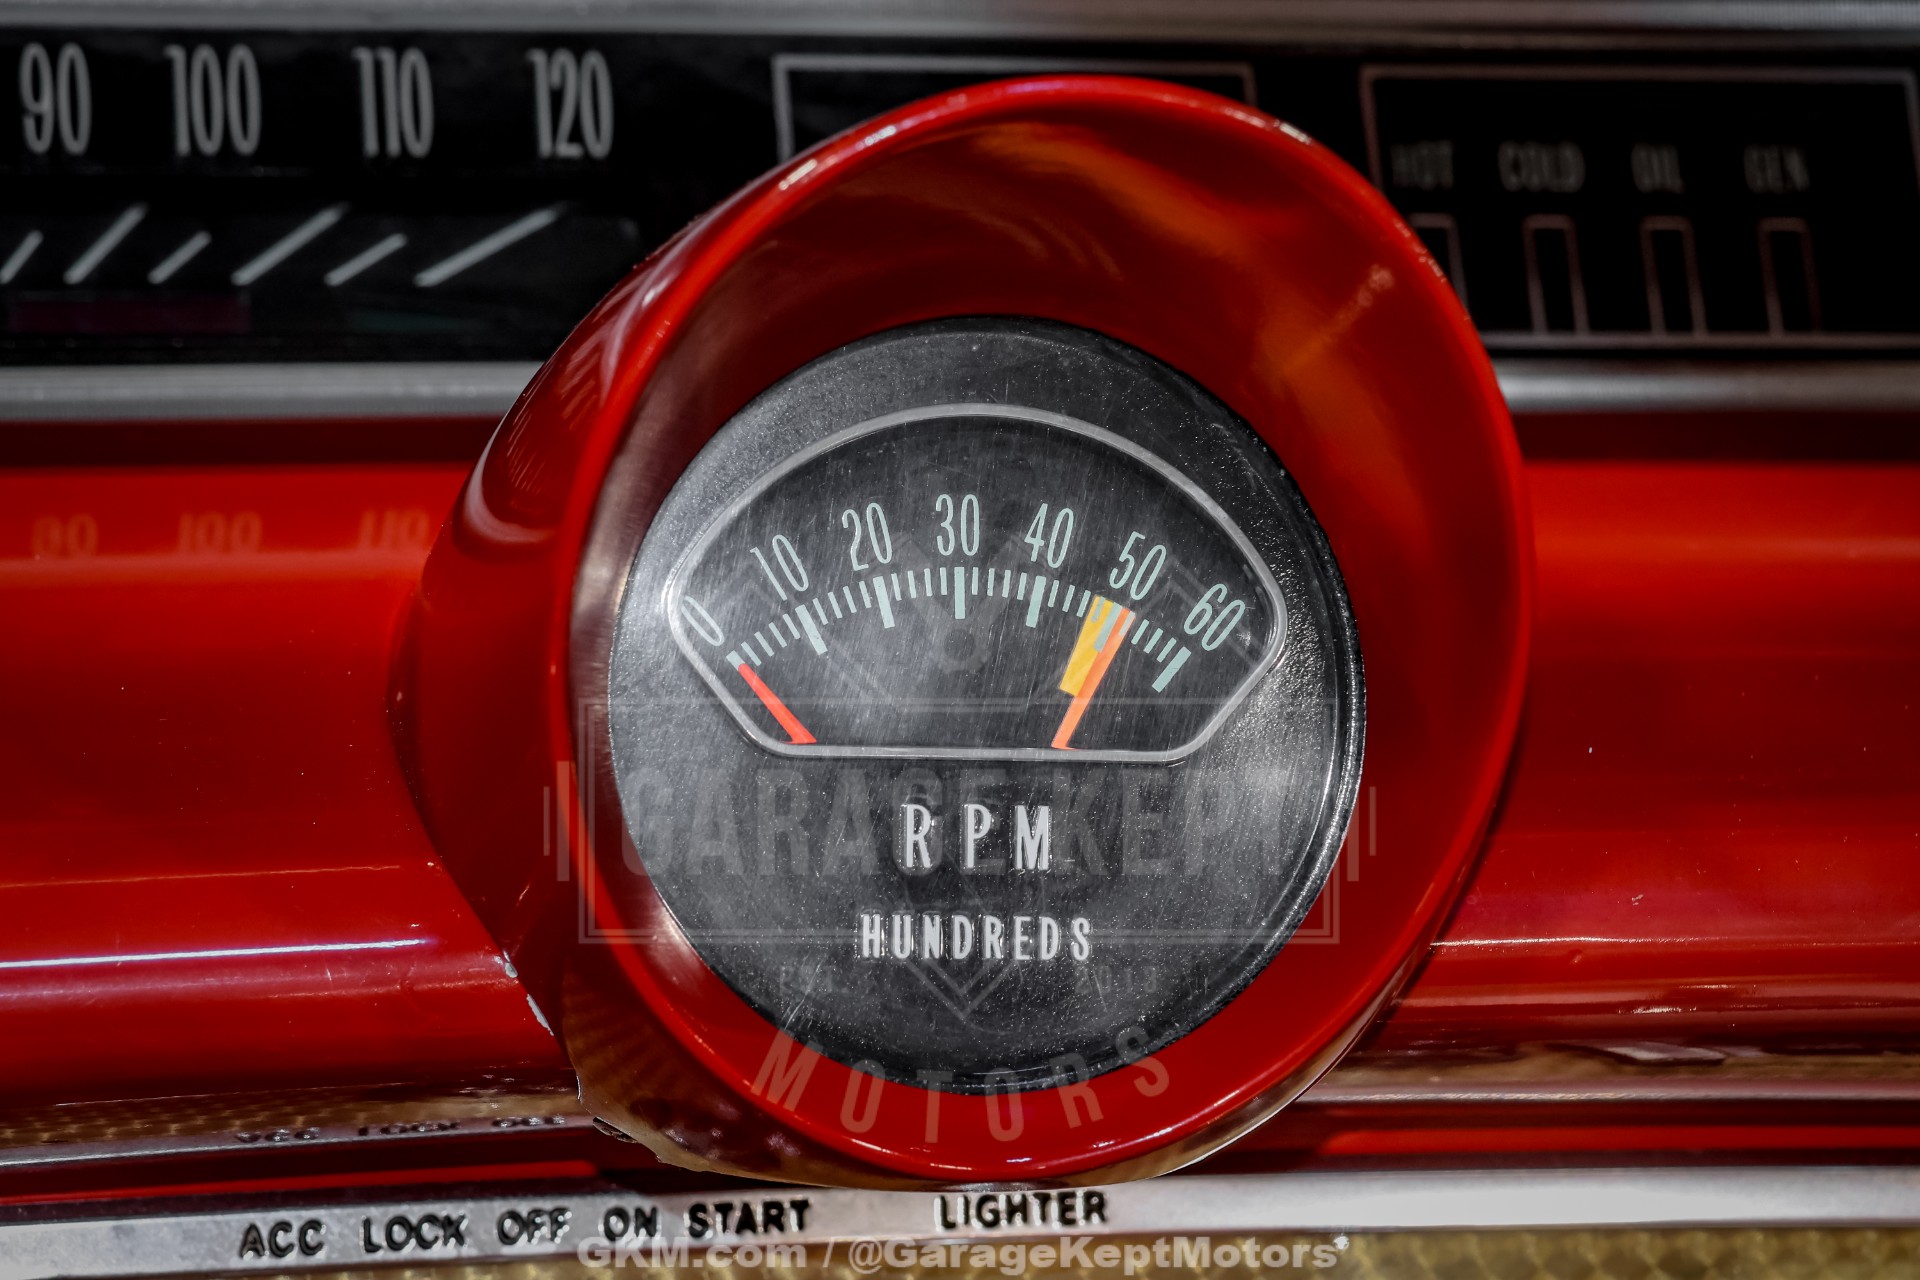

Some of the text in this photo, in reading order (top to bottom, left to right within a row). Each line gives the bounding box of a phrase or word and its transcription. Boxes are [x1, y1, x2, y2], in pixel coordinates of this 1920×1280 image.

[20, 43, 91, 155] 90
[163, 44, 261, 157] 100
[351, 46, 435, 159] 110
[525, 49, 613, 159] 120
[1497, 140, 1586, 192] COLD
[1631, 142, 1683, 193] OIL
[842, 502, 893, 571] 20
[935, 494, 981, 556] 30
[1024, 503, 1074, 568] 40
[750, 534, 809, 600] 10
[1109, 531, 1167, 600] 50
[682, 596, 725, 646] 0
[1184, 582, 1246, 651] 60
[901, 803, 1053, 872] RPM
[860, 911, 1092, 962] HUNDREDS
[240, 1220, 325, 1259] ACC
[362, 1213, 466, 1254] LOCK
[499, 1208, 571, 1246] OFF
[603, 1206, 659, 1242] ON
[686, 1198, 810, 1238] START
[935, 1190, 1109, 1231] LIGHTER
